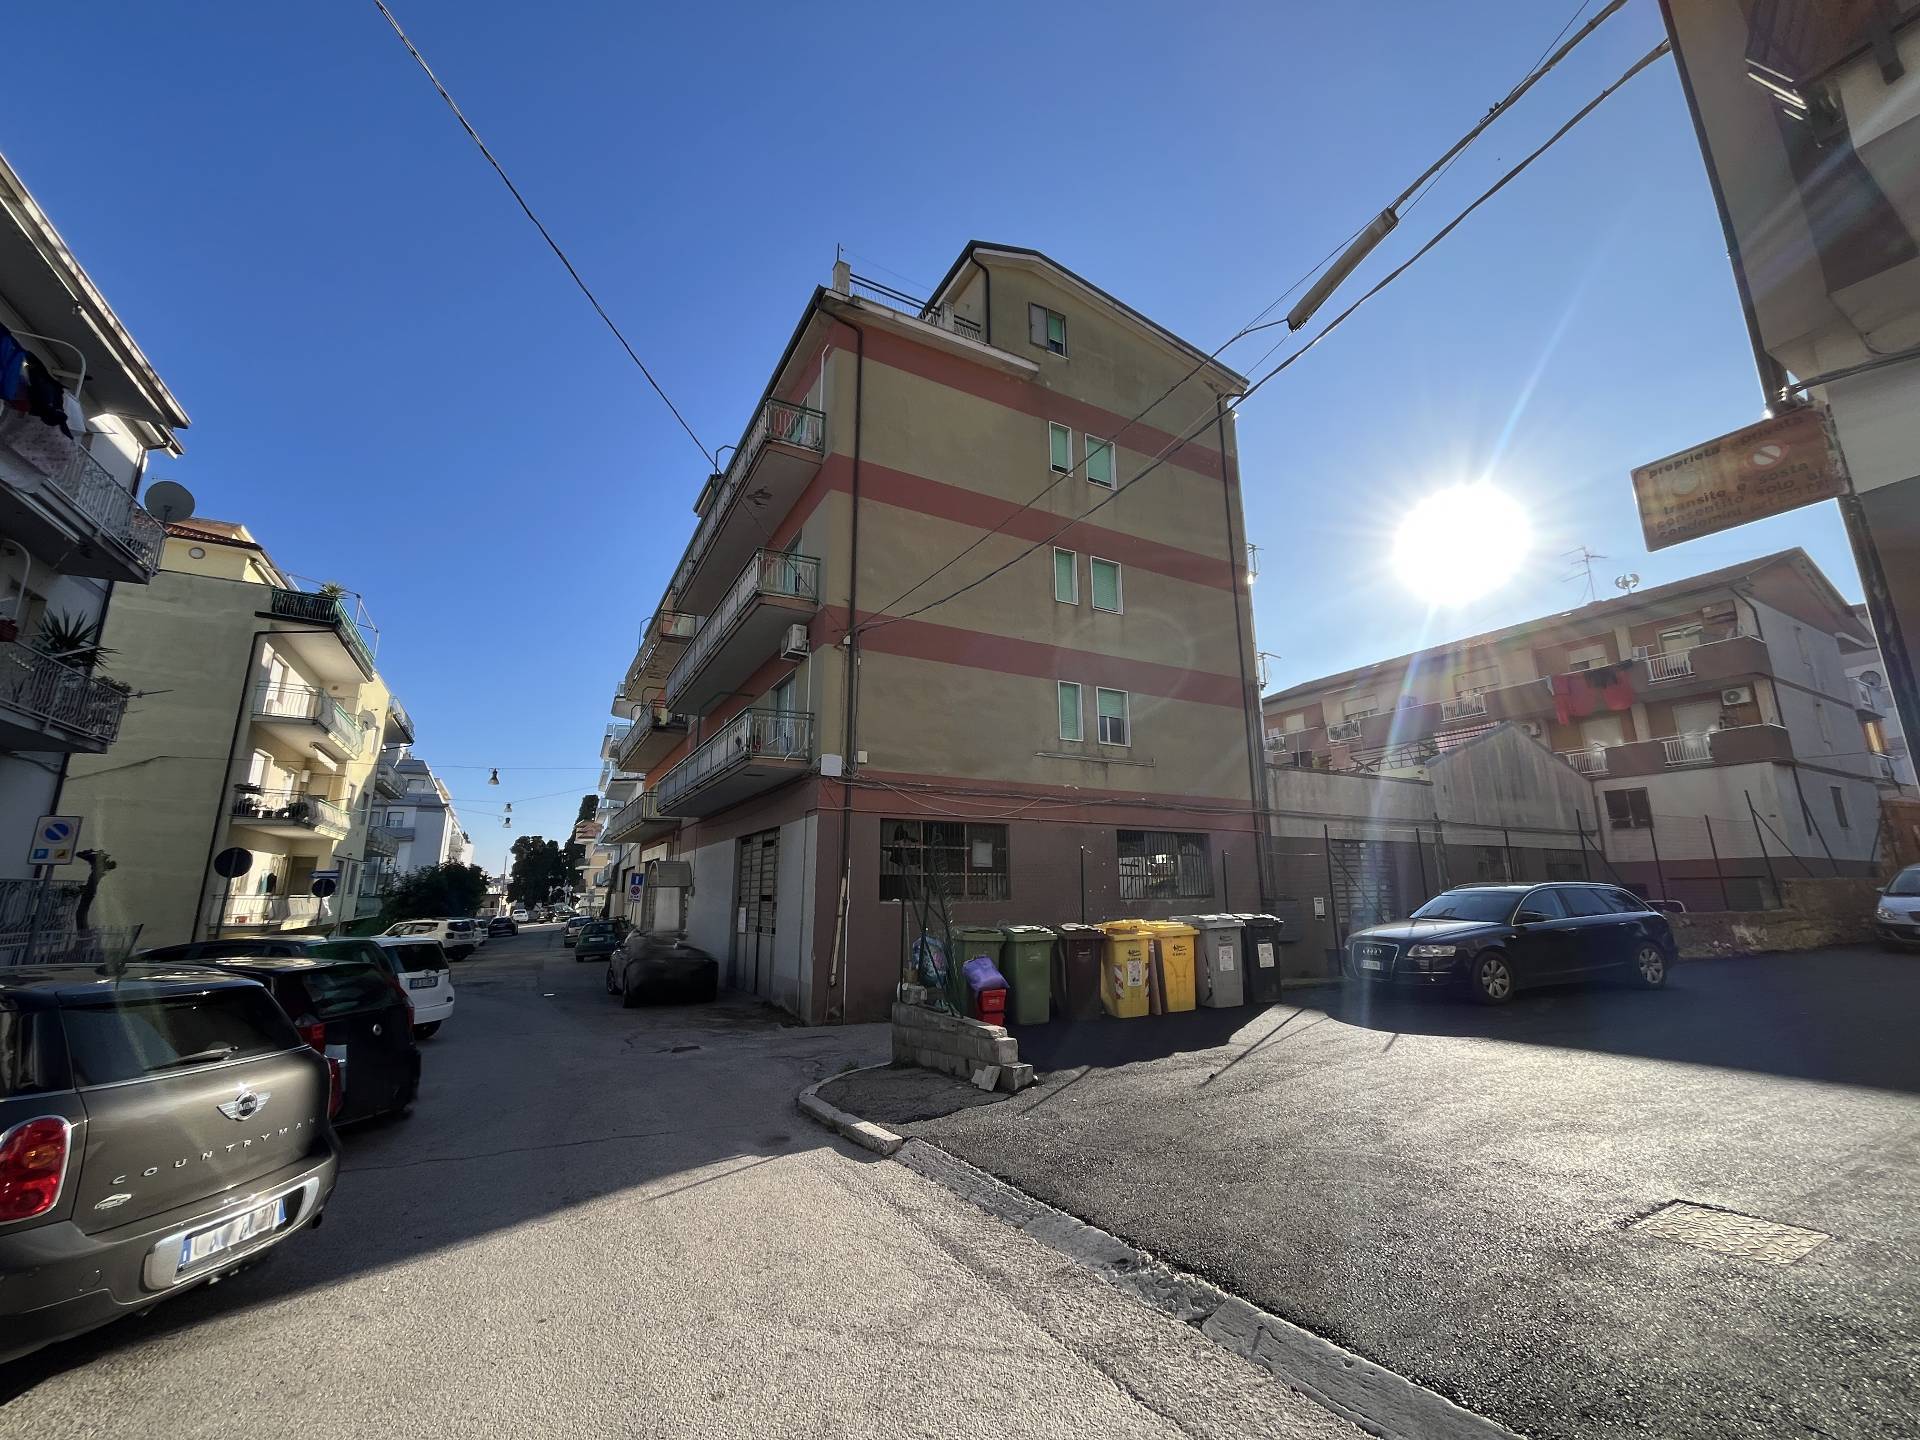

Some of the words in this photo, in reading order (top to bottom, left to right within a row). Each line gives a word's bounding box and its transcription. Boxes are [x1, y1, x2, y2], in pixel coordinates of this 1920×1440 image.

[1656, 496, 1745, 528] consentito
[1757, 479, 1795, 496] solo
[1664, 490, 1726, 514] transito
[1737, 482, 1747, 492] e
[1759, 462, 1809, 485] sosta
[111, 1117, 316, 1185] COUNTRYMAN
